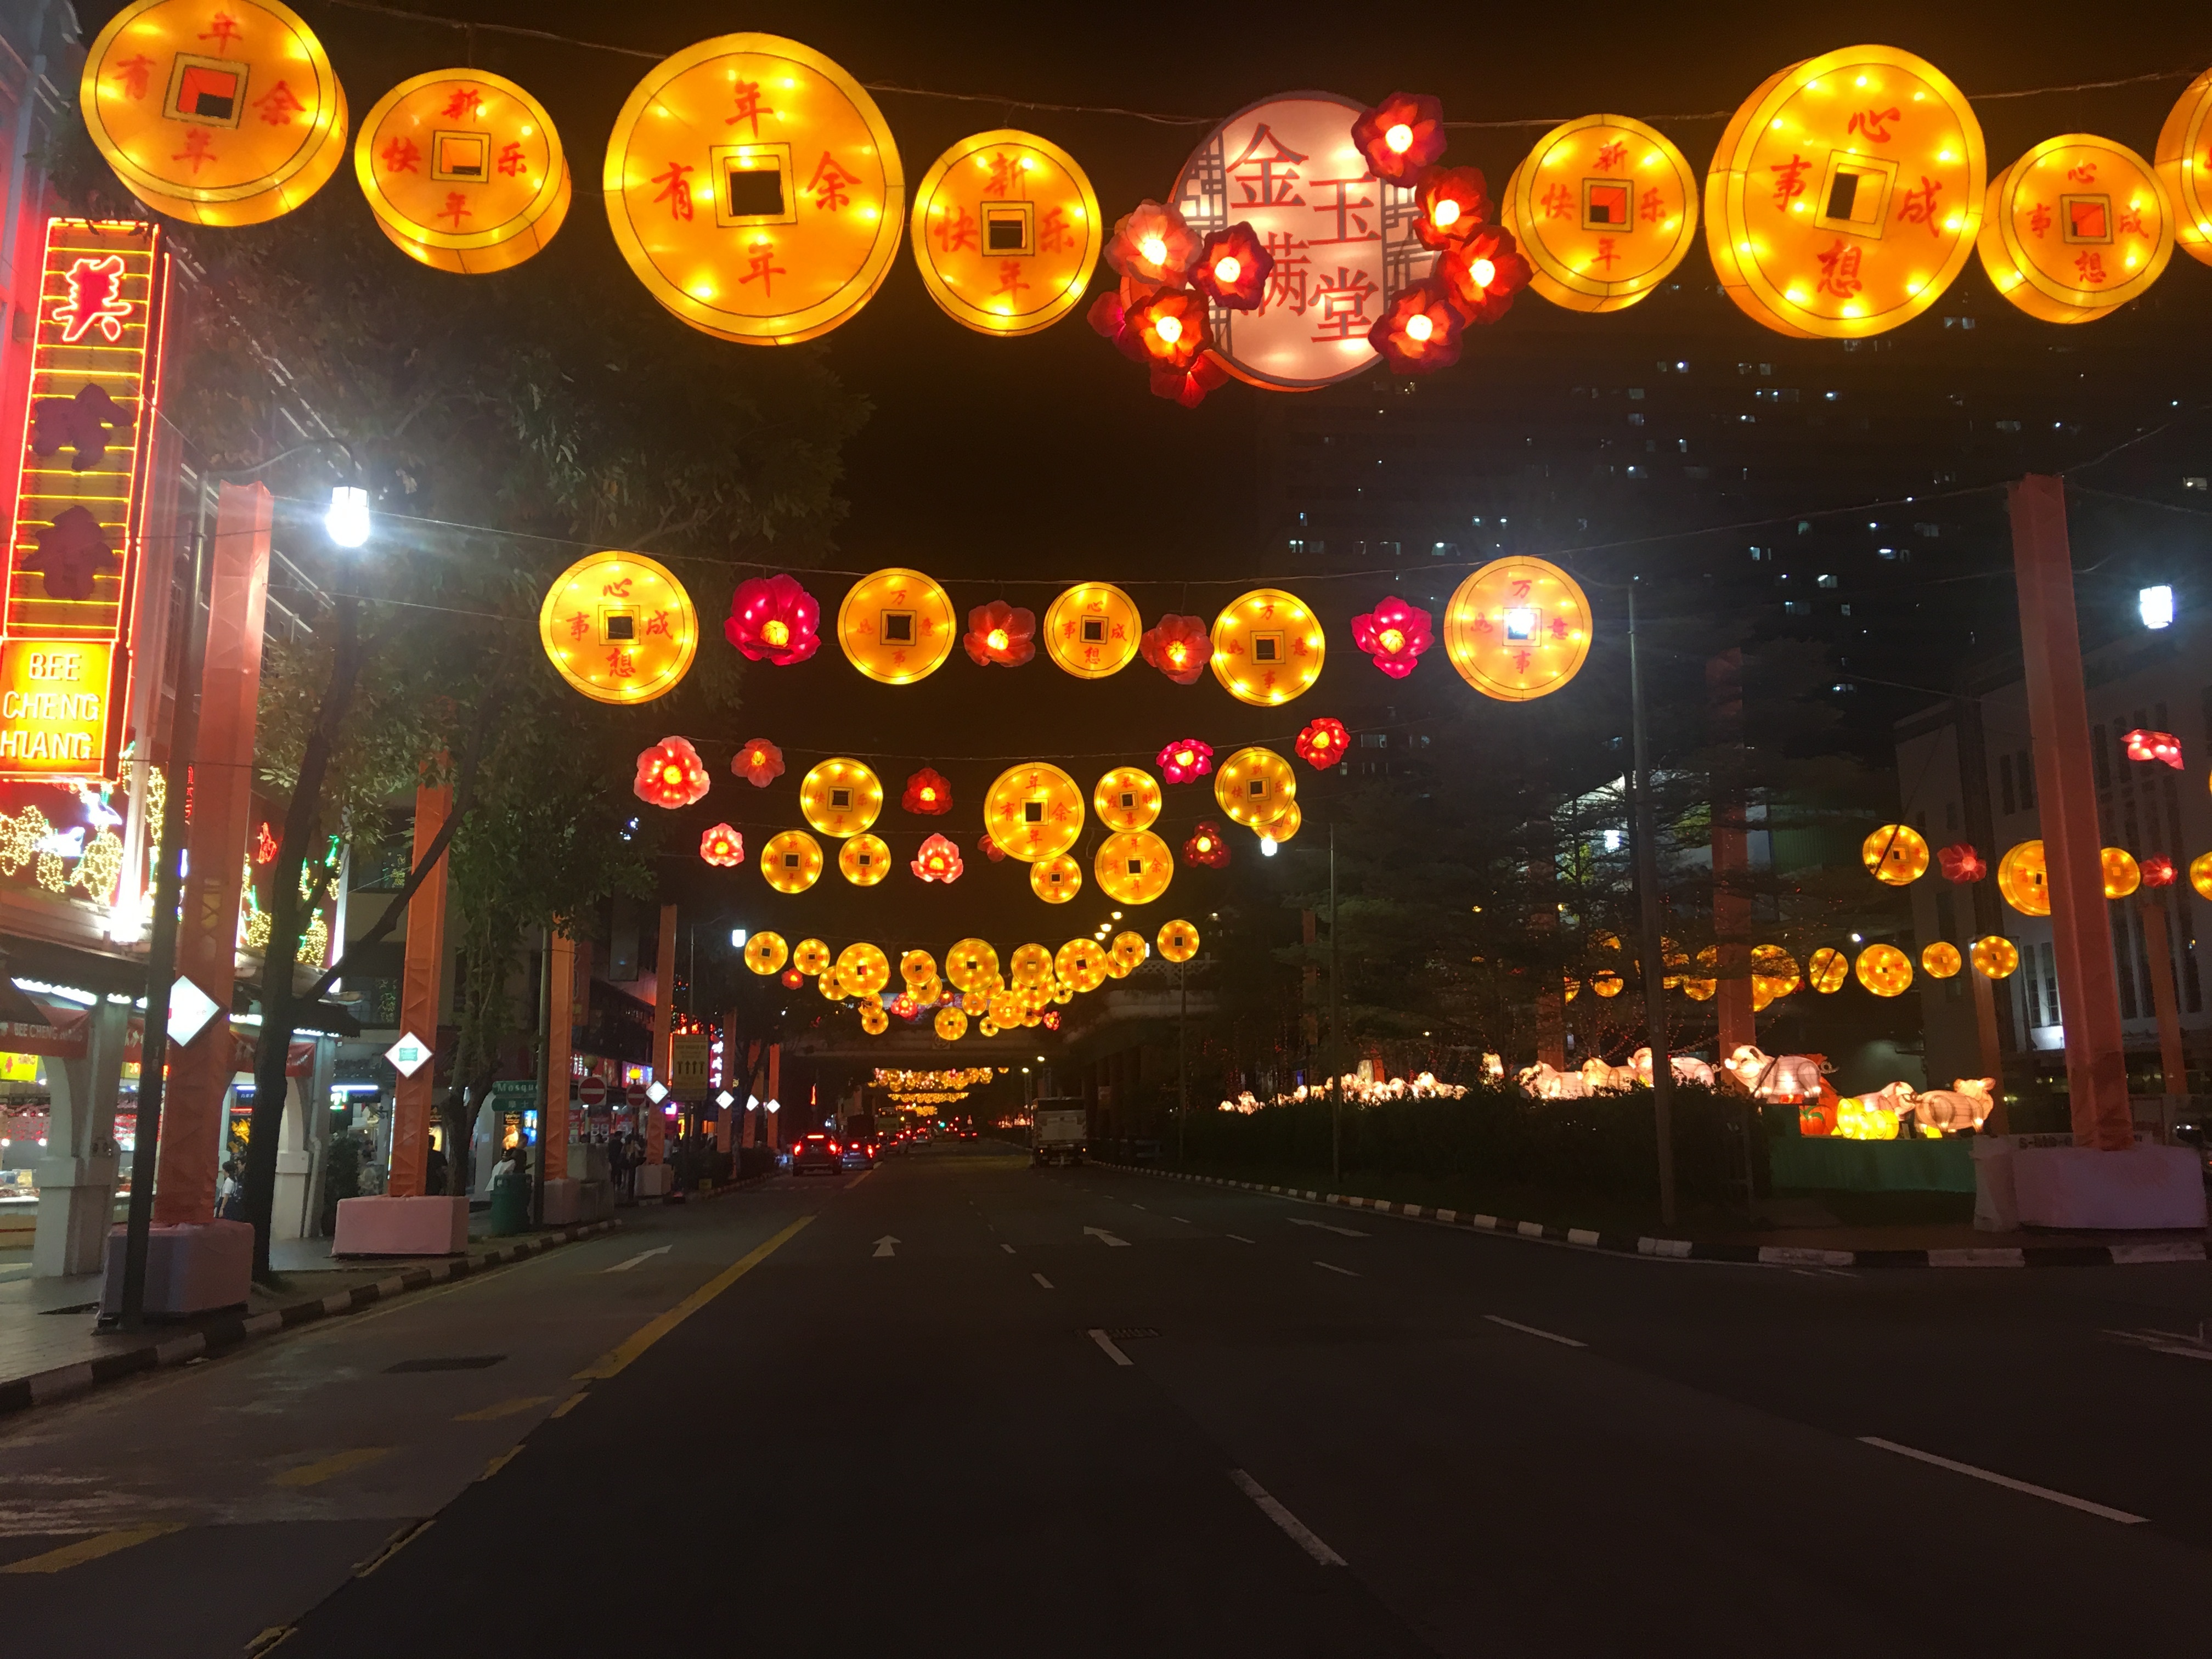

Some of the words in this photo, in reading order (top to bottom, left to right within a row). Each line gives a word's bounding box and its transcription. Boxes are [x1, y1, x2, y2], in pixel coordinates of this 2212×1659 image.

[198, 12, 244, 55] 年
[114, 55, 156, 99] 有
[252, 80, 306, 126] 余
[441, 88, 483, 122] 新
[725, 80, 774, 138] 年
[1847, 108, 1901, 144] 心
[172, 128, 216, 173] 年
[381, 136, 421, 174] 快
[497, 142, 528, 177] 乐
[1593, 140, 1628, 171] 新
[806, 151, 861, 211] 余
[983, 152, 1026, 200] 新
[1769, 154, 1813, 211] 事
[2068, 162, 2097, 185] 心
[651, 162, 694, 222] 有
[1541, 183, 1575, 219] 快
[1639, 187, 1667, 223] 乐
[1897, 177, 1943, 239] 成
[436, 192, 471, 228] 年
[2026, 202, 2052, 239] 事
[2118, 206, 2150, 240] 成
[933, 206, 980, 253] 快
[1039, 207, 1075, 252] 乐
[738, 242, 786, 298] 年
[1590, 238, 1622, 272] 年
[1816, 239, 1863, 299] 想
[2073, 250, 2107, 283] 想
[991, 261, 1030, 306] 年
[602, 578, 632, 598] 心
[1511, 579, 1533, 599] 万
[1087, 600, 1103, 612] 心
[1259, 604, 1274, 620] 万
[566, 612, 590, 641] 事
[646, 610, 673, 640] 成
[1062, 620, 1075, 639] 事
[1111, 623, 1127, 641] 成
[1547, 616, 1568, 640] 意
[606, 648, 636, 678] 想
[1084, 647, 1101, 664] 想
[1290, 636, 1308, 657] 意
[1513, 650, 1531, 675] 事
[29, 653, 82, 681] BEE
[1262, 670, 1276, 689] 事
[3, 691, 101, 721] CHENG
[0, 730, 94, 760] HIANG
[1025, 775, 1042, 793] 年
[1000, 802, 1015, 821] 有
[1051, 802, 1072, 821] 余
[1026, 829, 1042, 848] 年
[14, 1023, 28, 1037] BEE
[29, 1024, 58, 1040] CHENG
[498, 1083, 538, 1093] Mosqu
